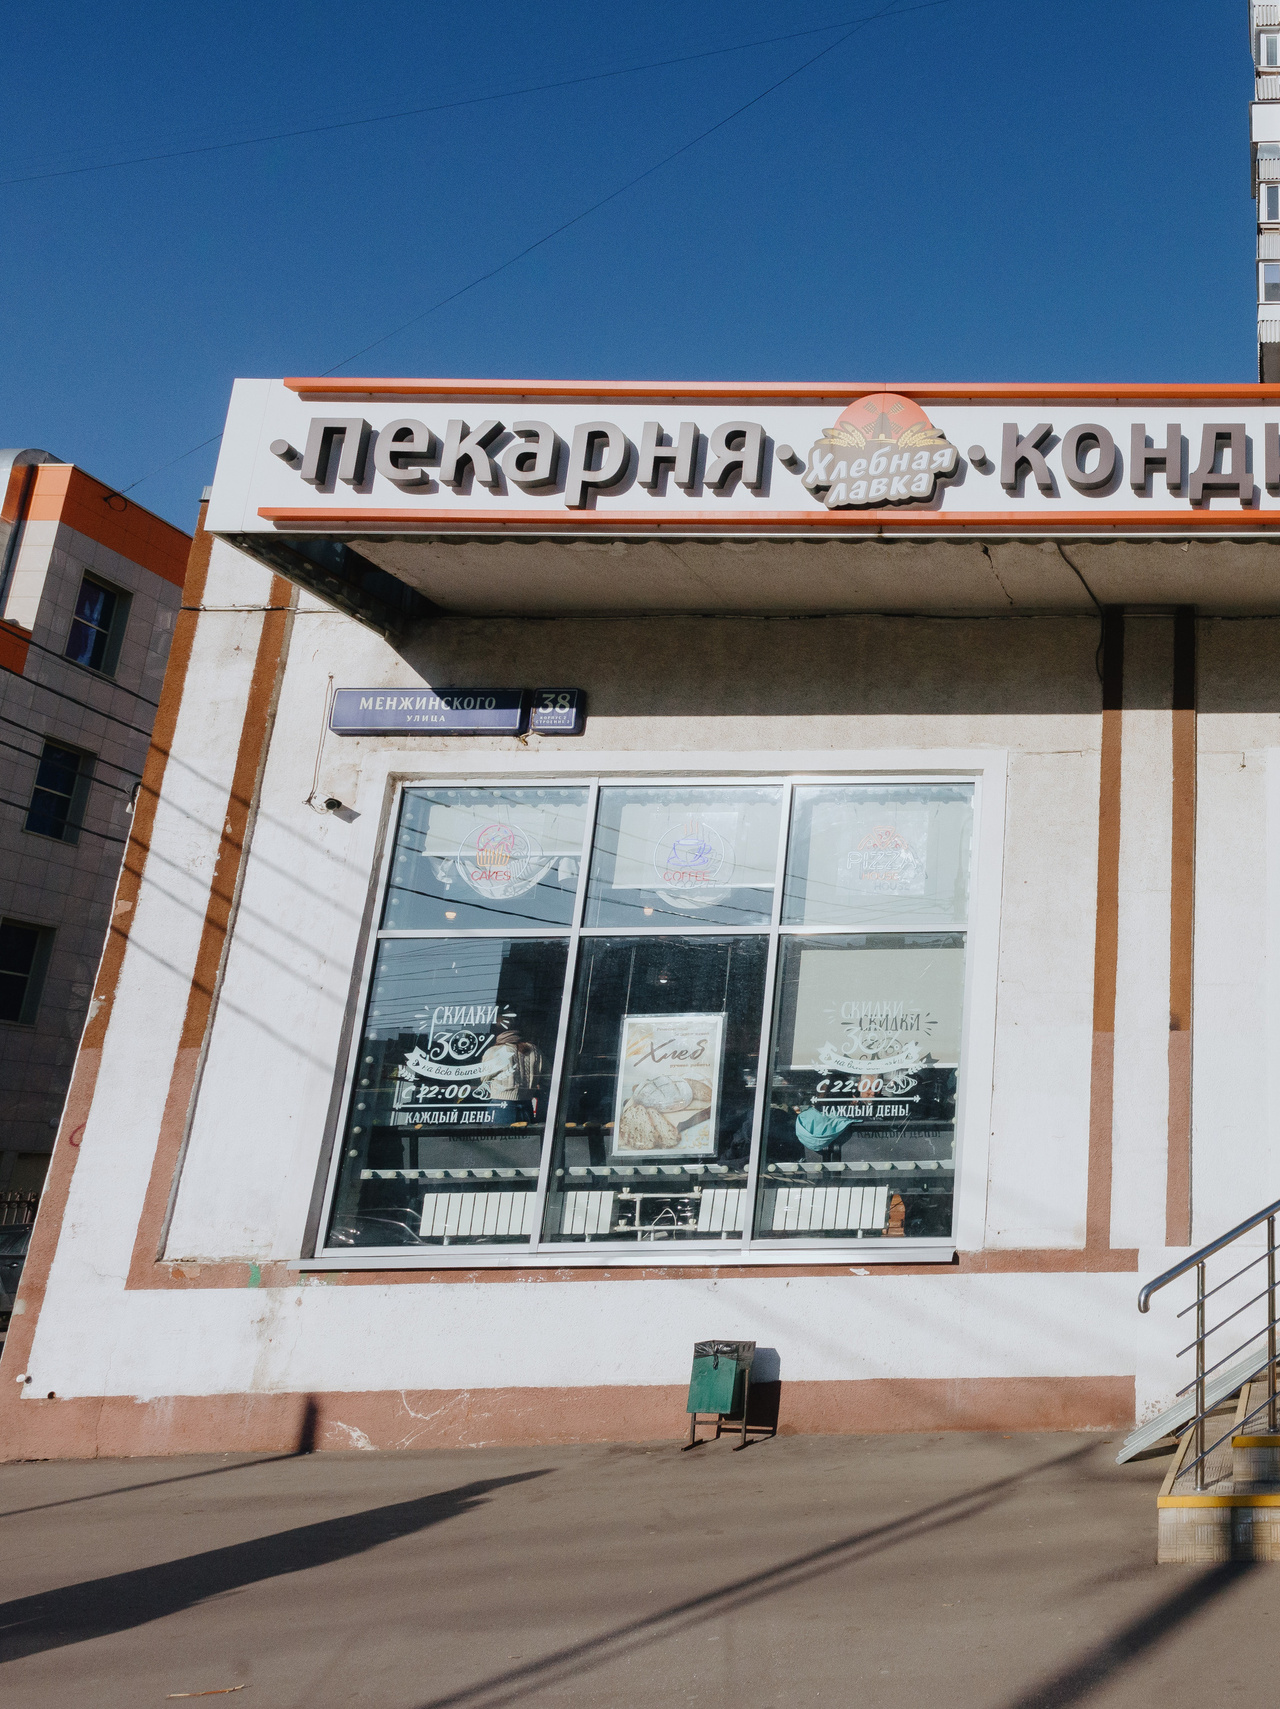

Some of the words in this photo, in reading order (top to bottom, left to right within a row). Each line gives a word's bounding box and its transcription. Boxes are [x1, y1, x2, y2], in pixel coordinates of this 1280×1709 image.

[300, 417, 766, 510] пекарня
[805, 445, 954, 485] Хлебная
[828, 472, 931, 503] лавка
[359, 696, 497, 711] МЕНЖИНСКОГО
[538, 693, 571, 714] 38
[406, 714, 446, 722] УЛИЦА
[846, 850, 917, 870] PIZZA
[470, 870, 511, 882] CAKES
[663, 870, 711, 882] COFFEE
[862, 871, 899, 881] HOUSE
[434, 1005, 499, 1026] СКИДКИ
[840, 1000, 904, 1019] СКИДКИ
[633, 1038, 709, 1068] Хлеб
[830, 1078, 884, 1093] 22:00
[406, 1109, 458, 1125] КАЖДЫЙ
[460, 1110, 496, 1124] ДЕНЬ!
[822, 1103, 873, 1117] КАЖДЫЙ
[875, 1104, 910, 1117] ДЕНЬ!
